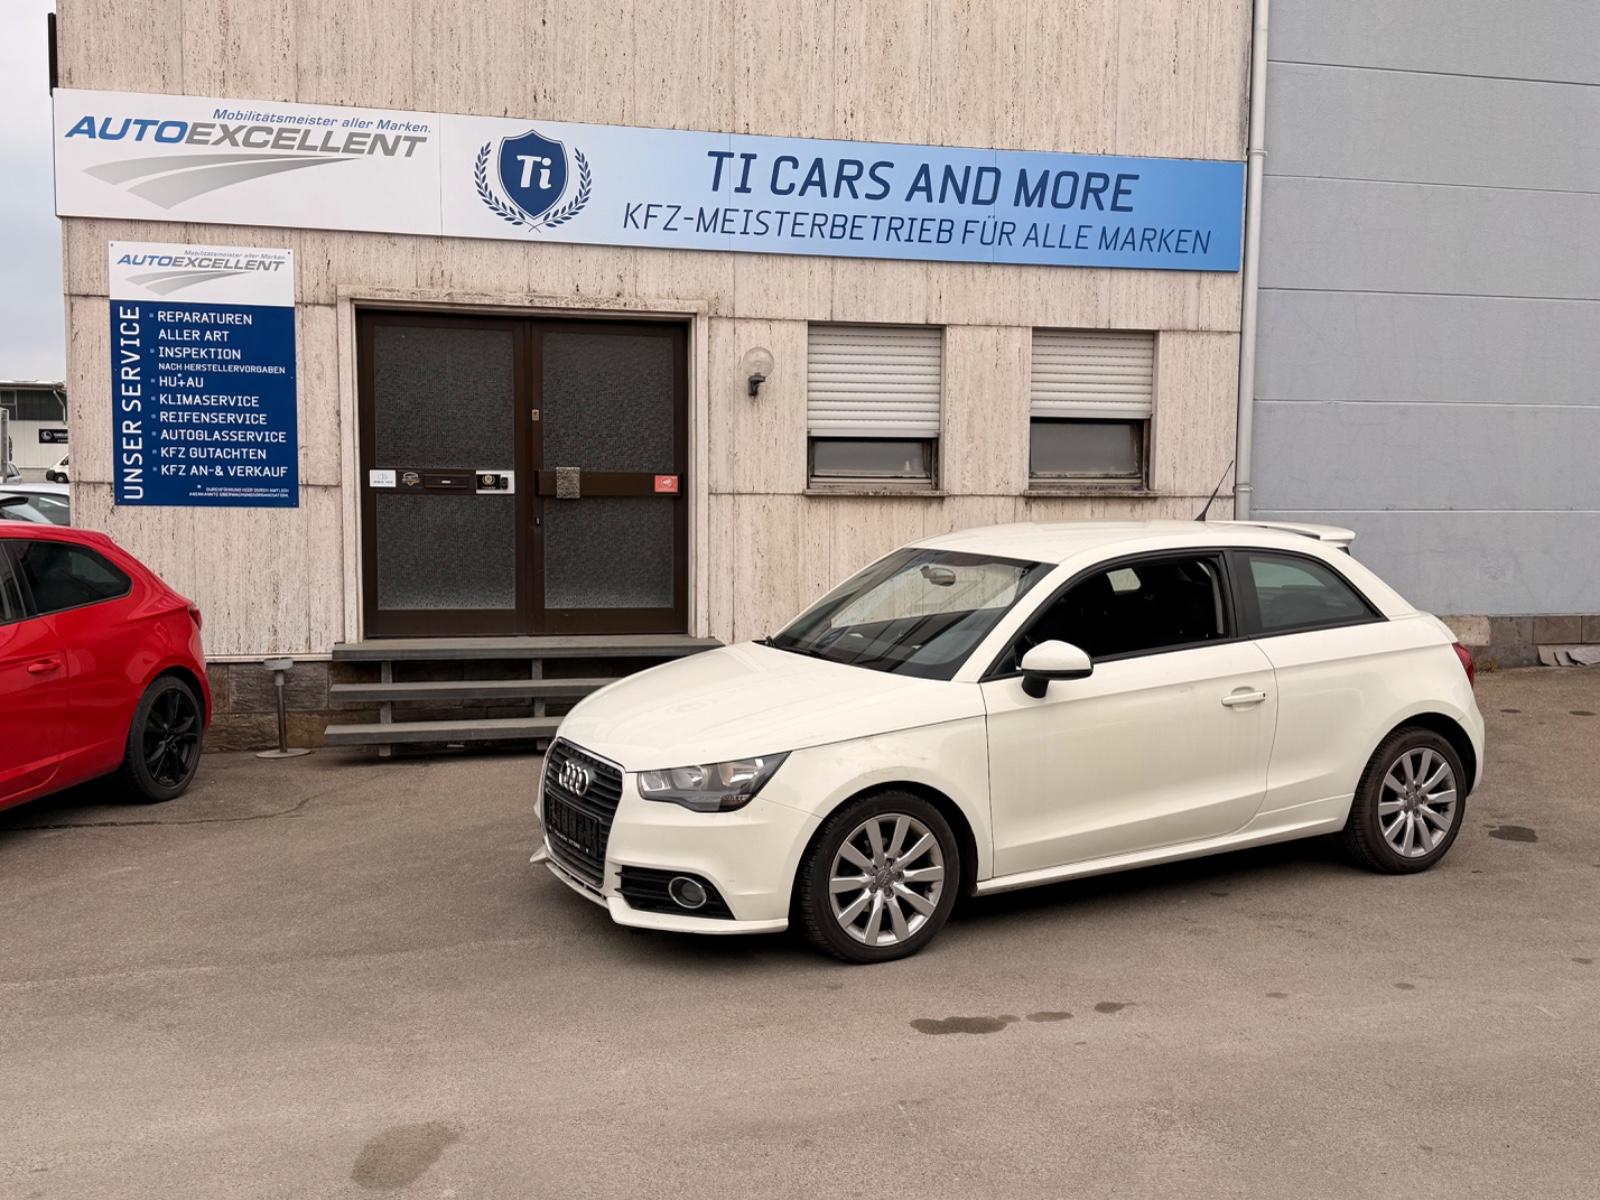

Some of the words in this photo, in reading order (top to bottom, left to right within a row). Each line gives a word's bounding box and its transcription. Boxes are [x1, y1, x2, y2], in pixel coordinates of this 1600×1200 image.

[213, 108, 338, 127] Mobilitätsmeister
[342, 117, 374, 131] aller
[377, 119, 431, 134] Marken.
[516, 154, 553, 191] Ti
[707, 150, 757, 194] TI
[769, 155, 895, 201] CARS
[904, 163, 1002, 206] AND
[1012, 168, 1140, 213] MORE
[622, 202, 955, 244] KFZ-MEISTERBETRIEB
[961, 215, 1017, 247] FÜR
[1022, 222, 1093, 250] ALLE
[1097, 226, 1212, 255] MARKEN
[157, 310, 253, 325] REPARATUREN
[158, 328, 201, 341] ALLER
[204, 330, 230, 342] ART
[119, 305, 142, 412] SERVICE
[158, 346, 242, 360] INSPEKTION
[158, 362, 183, 371] NACH
[159, 393, 260, 407] KLIMASERVICE
[160, 411, 268, 425] REIFENSERVICE
[160, 429, 287, 443] AUTOGLASSERVICE
[122, 419, 144, 499] UNSER
[161, 446, 186, 458] KFZ
[189, 447, 267, 460] GUTACHTEN
[161, 464, 187, 476] KFZ
[227, 466, 289, 478] VERKAUF
